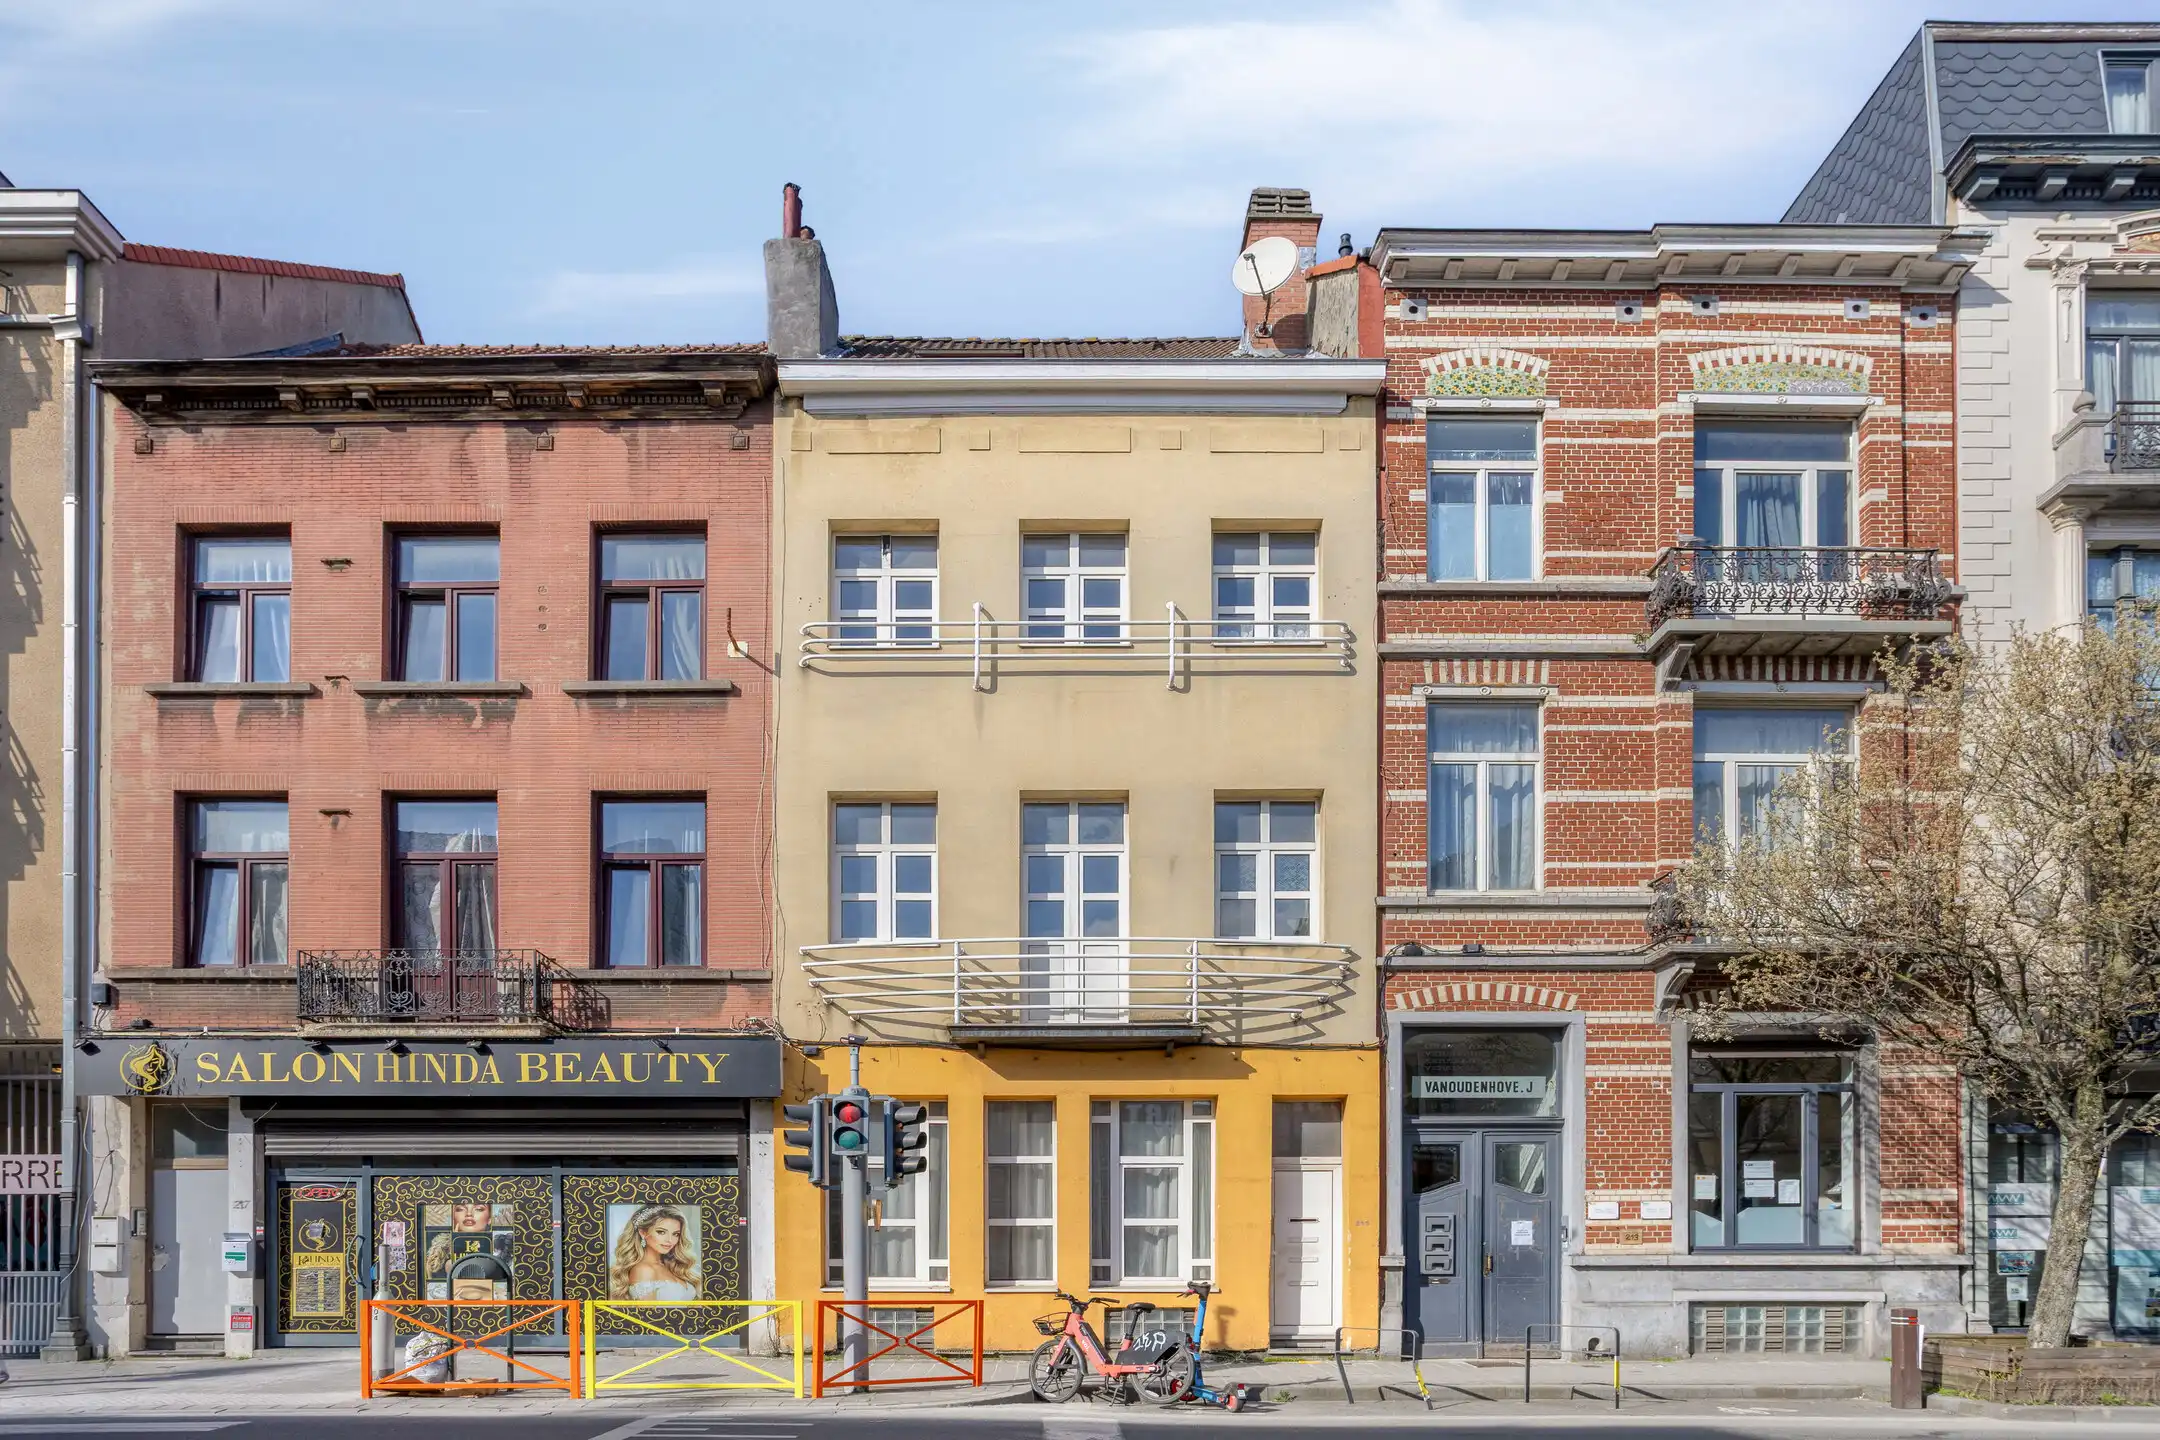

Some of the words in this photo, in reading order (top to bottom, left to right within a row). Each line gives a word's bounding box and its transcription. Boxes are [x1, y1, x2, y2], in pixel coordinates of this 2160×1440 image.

[197, 1051, 365, 1084] SALON
[374, 1052, 505, 1084] HINDA
[516, 1052, 730, 1084] BEAUTY
[299, 1187, 340, 1197] OPEN
[1625, 1233, 1639, 1241] 213
